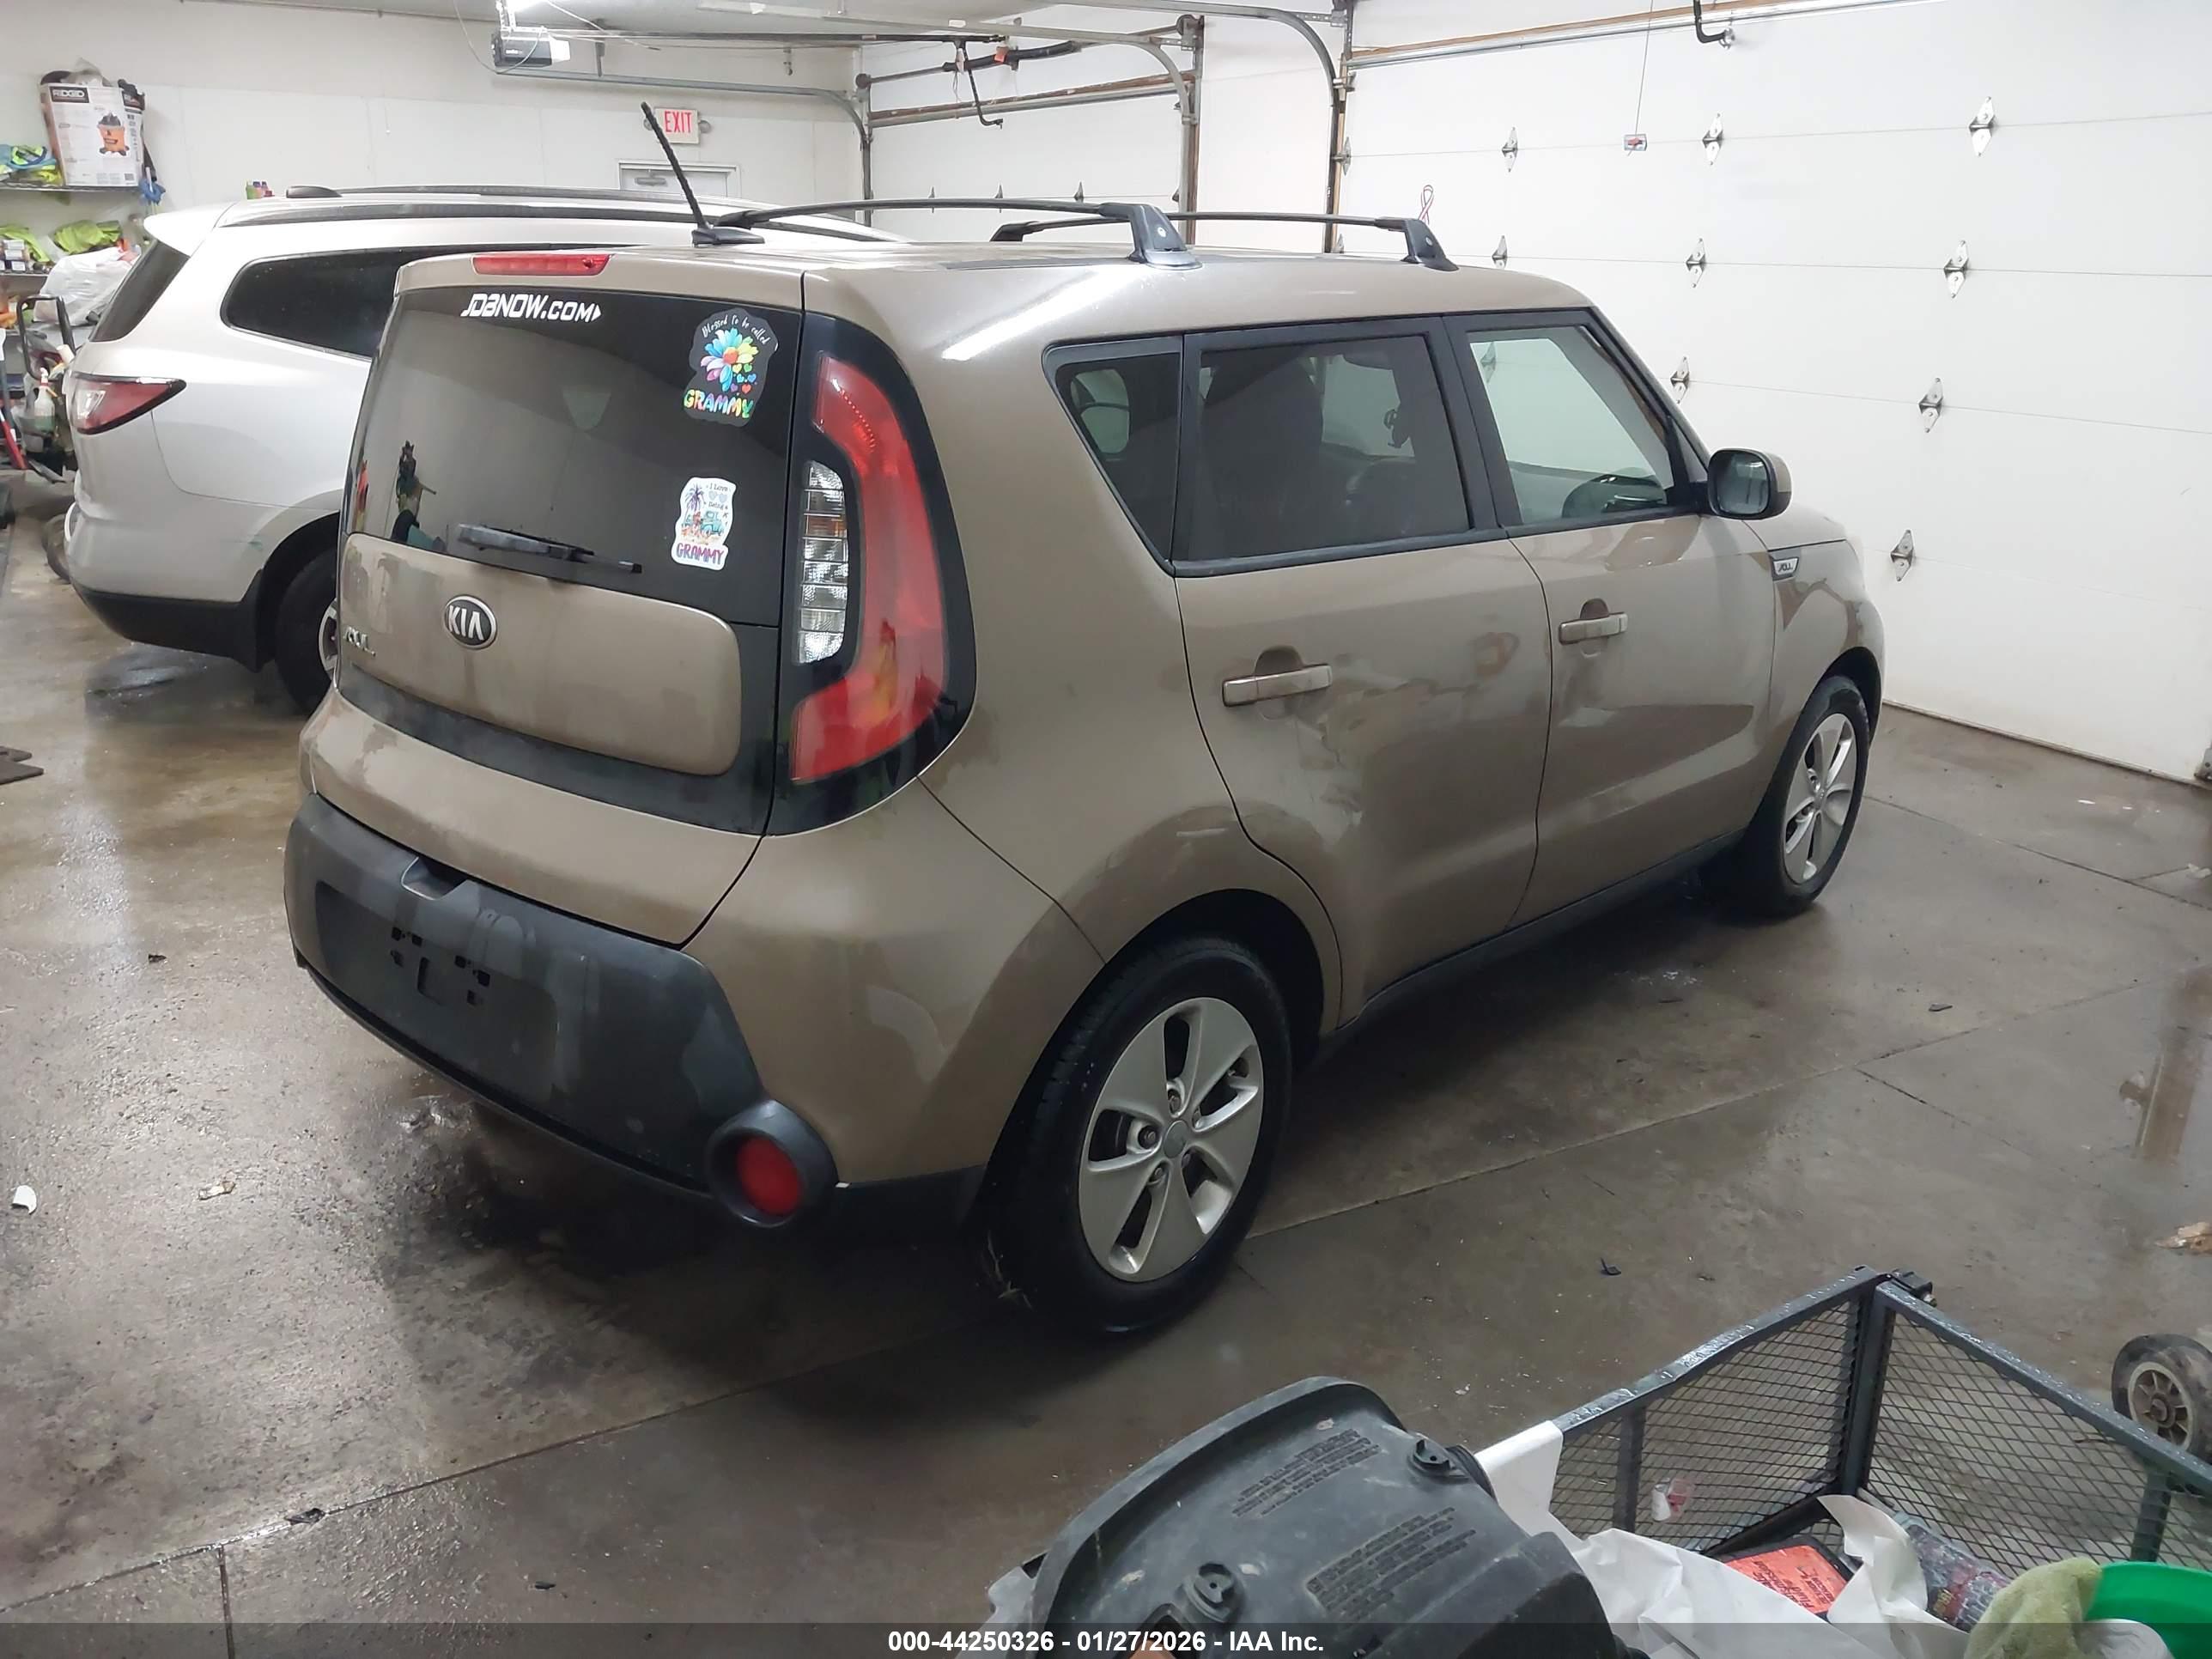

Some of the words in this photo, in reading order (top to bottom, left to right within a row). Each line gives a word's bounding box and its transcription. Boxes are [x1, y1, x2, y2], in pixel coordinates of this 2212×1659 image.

[664, 110, 692, 133] EXIT
[702, 314, 728, 337] Blessed
[742, 316, 750, 329] be
[751, 326, 771, 345] called
[684, 389, 754, 418] GRAMMY
[676, 542, 725, 565] GRAMMY
[448, 605, 485, 641] KIA
